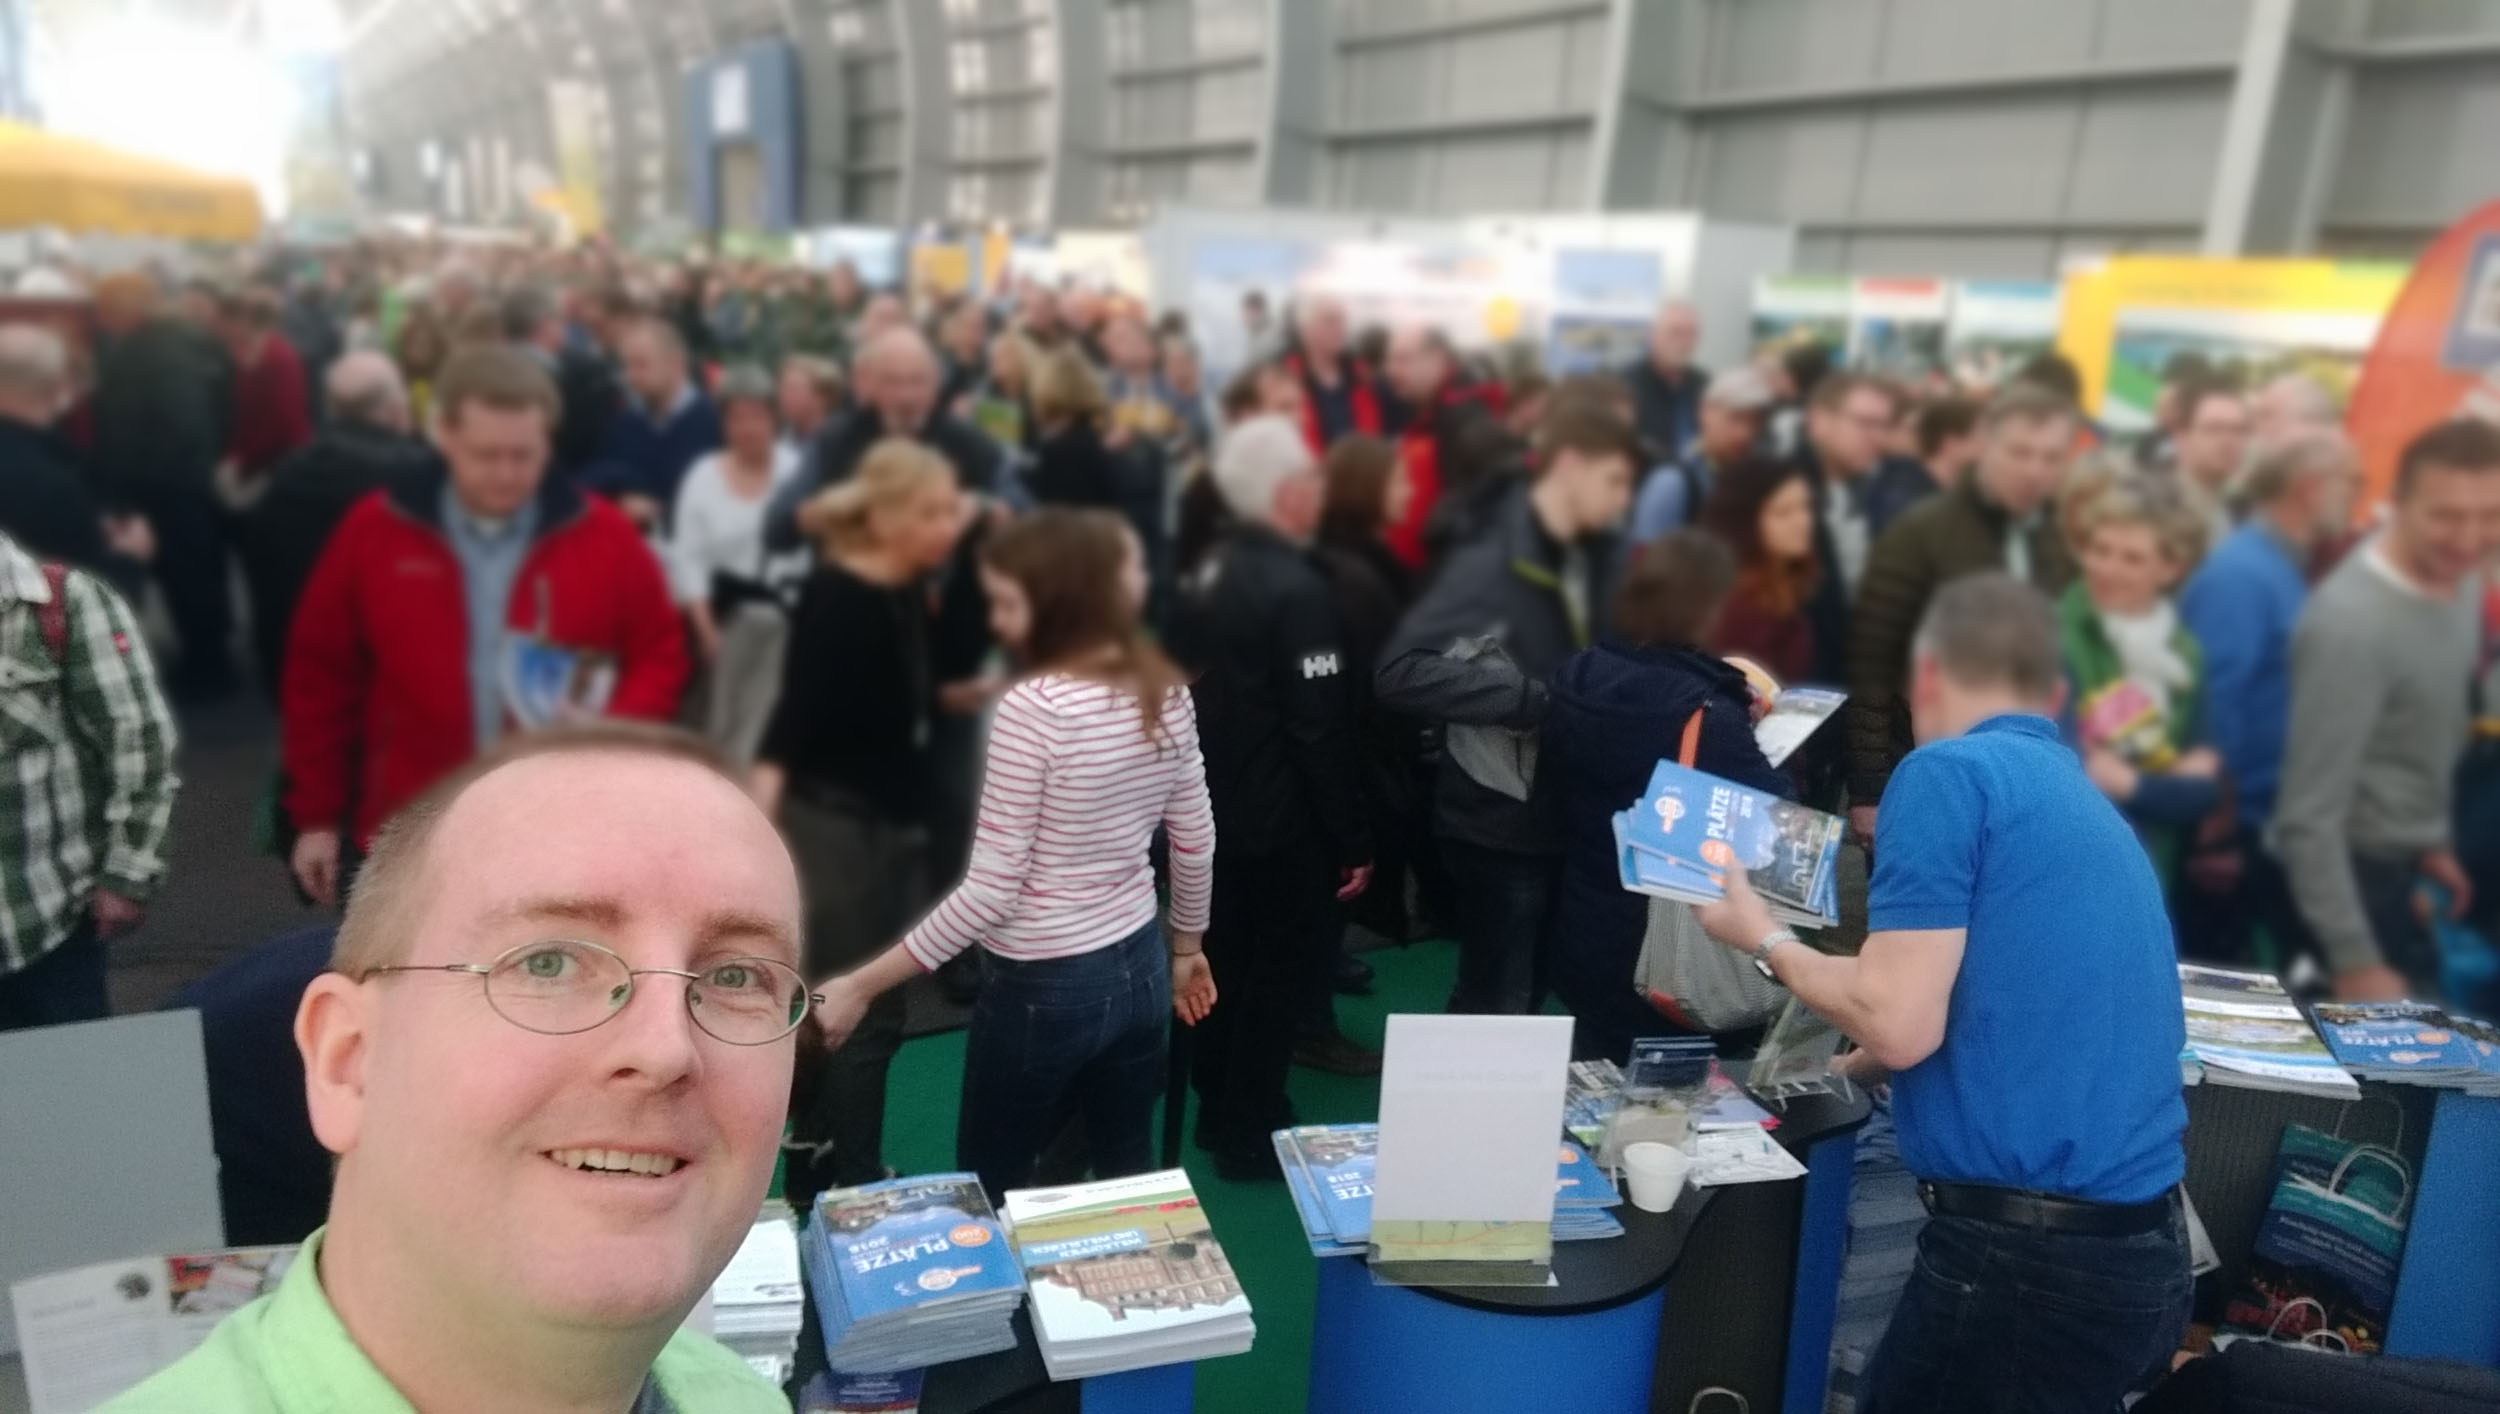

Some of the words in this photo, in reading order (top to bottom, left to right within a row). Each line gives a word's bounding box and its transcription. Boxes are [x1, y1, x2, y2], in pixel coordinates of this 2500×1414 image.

[1303, 653, 1338, 679] HH
[1706, 787, 1731, 839] PLÄTZE
[853, 1239, 949, 1274] PLÄTZE
